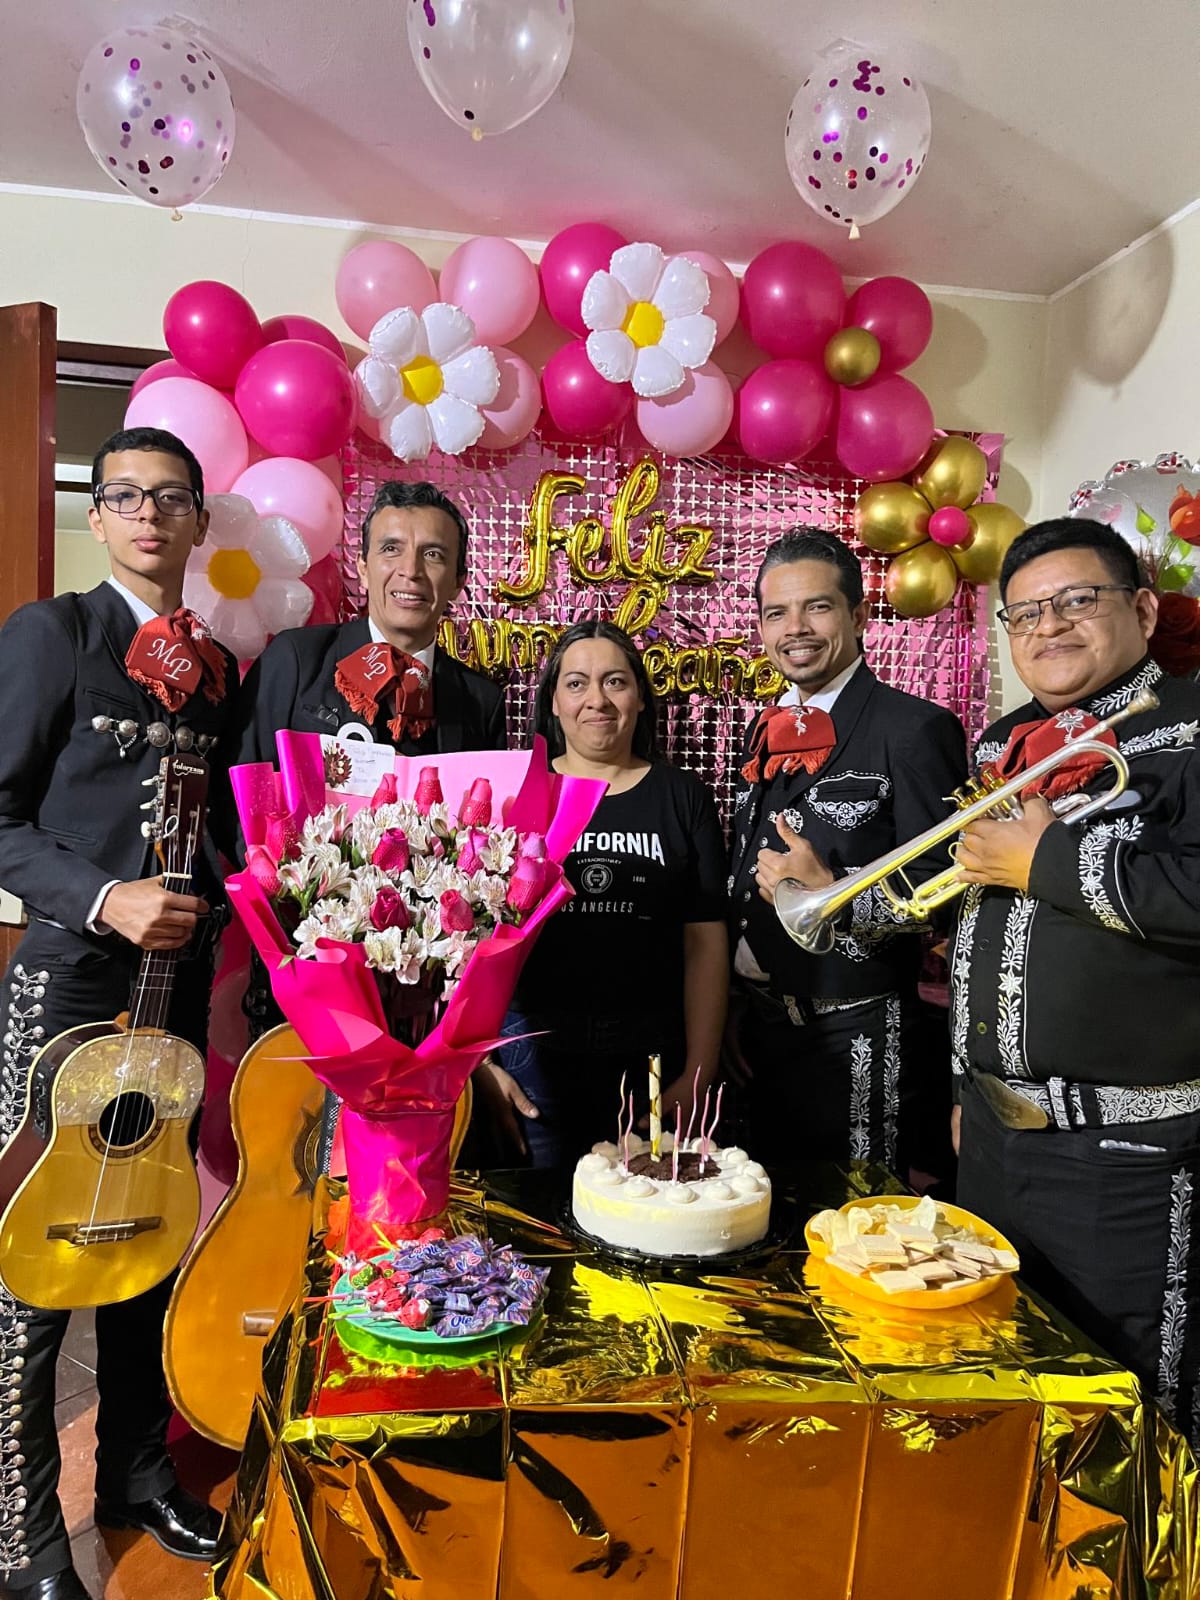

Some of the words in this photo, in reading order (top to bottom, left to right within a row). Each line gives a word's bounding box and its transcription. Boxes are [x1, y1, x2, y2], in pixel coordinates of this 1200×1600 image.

[147, 638, 193, 681] MP
[362, 646, 387, 681] MP
[570, 831, 665, 866] IFORNIA
[581, 901, 634, 913] ANGELES
